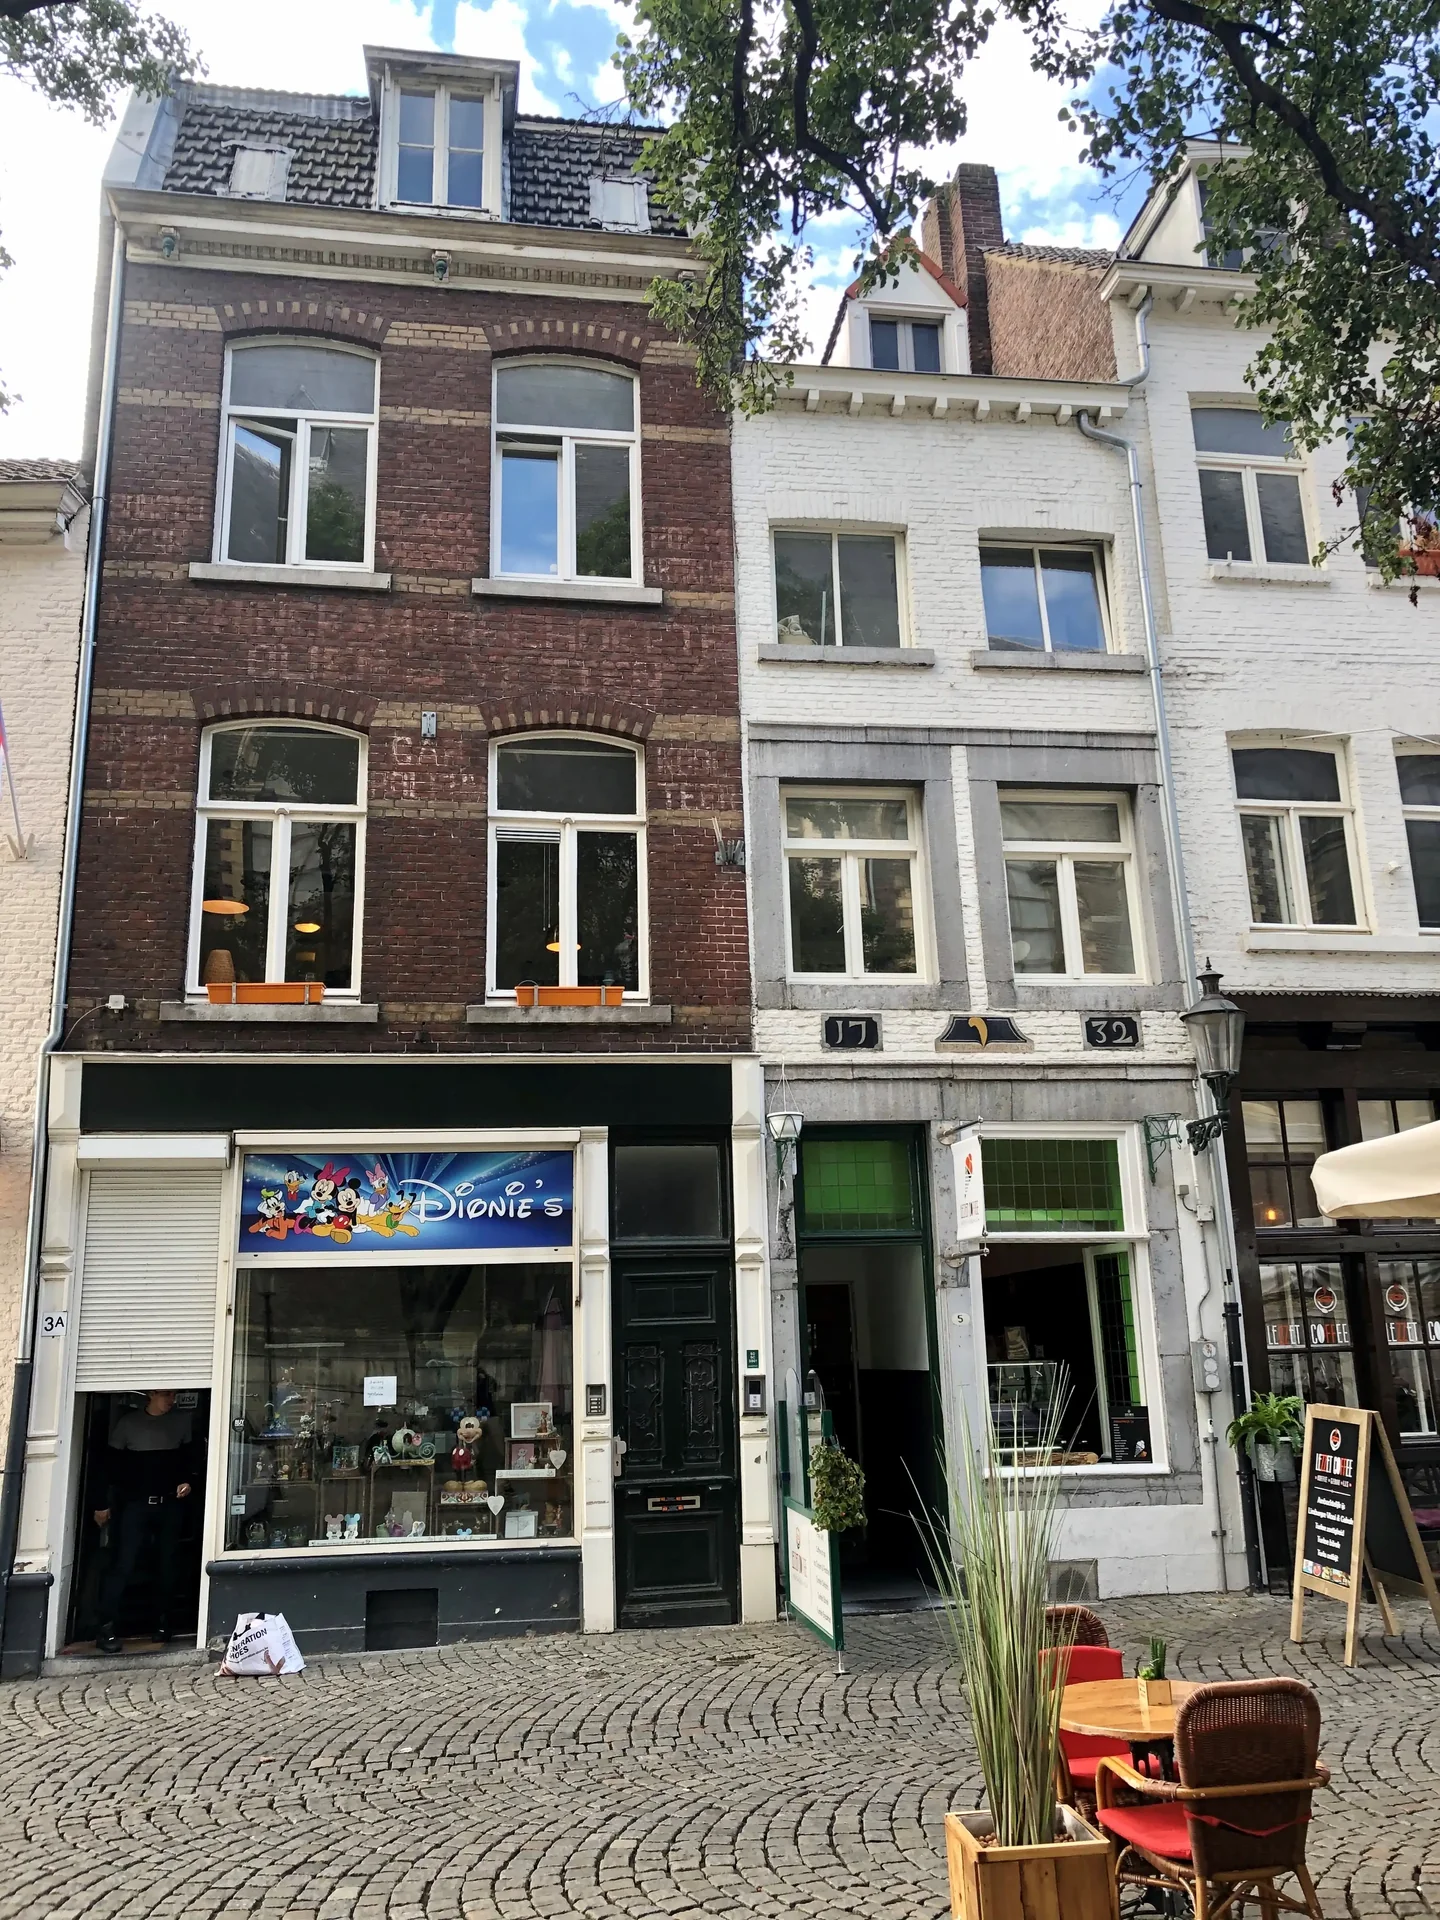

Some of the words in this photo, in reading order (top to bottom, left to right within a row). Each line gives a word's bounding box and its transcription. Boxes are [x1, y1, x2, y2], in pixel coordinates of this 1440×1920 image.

[835, 1020, 867, 1045] 17
[1091, 1020, 1133, 1044] 32
[44, 1316, 65, 1332] 3A
[957, 1314, 964, 1324] 5
[1310, 1323, 1350, 1344] COFFEE
[1333, 1456, 1354, 1478] COFFEE
